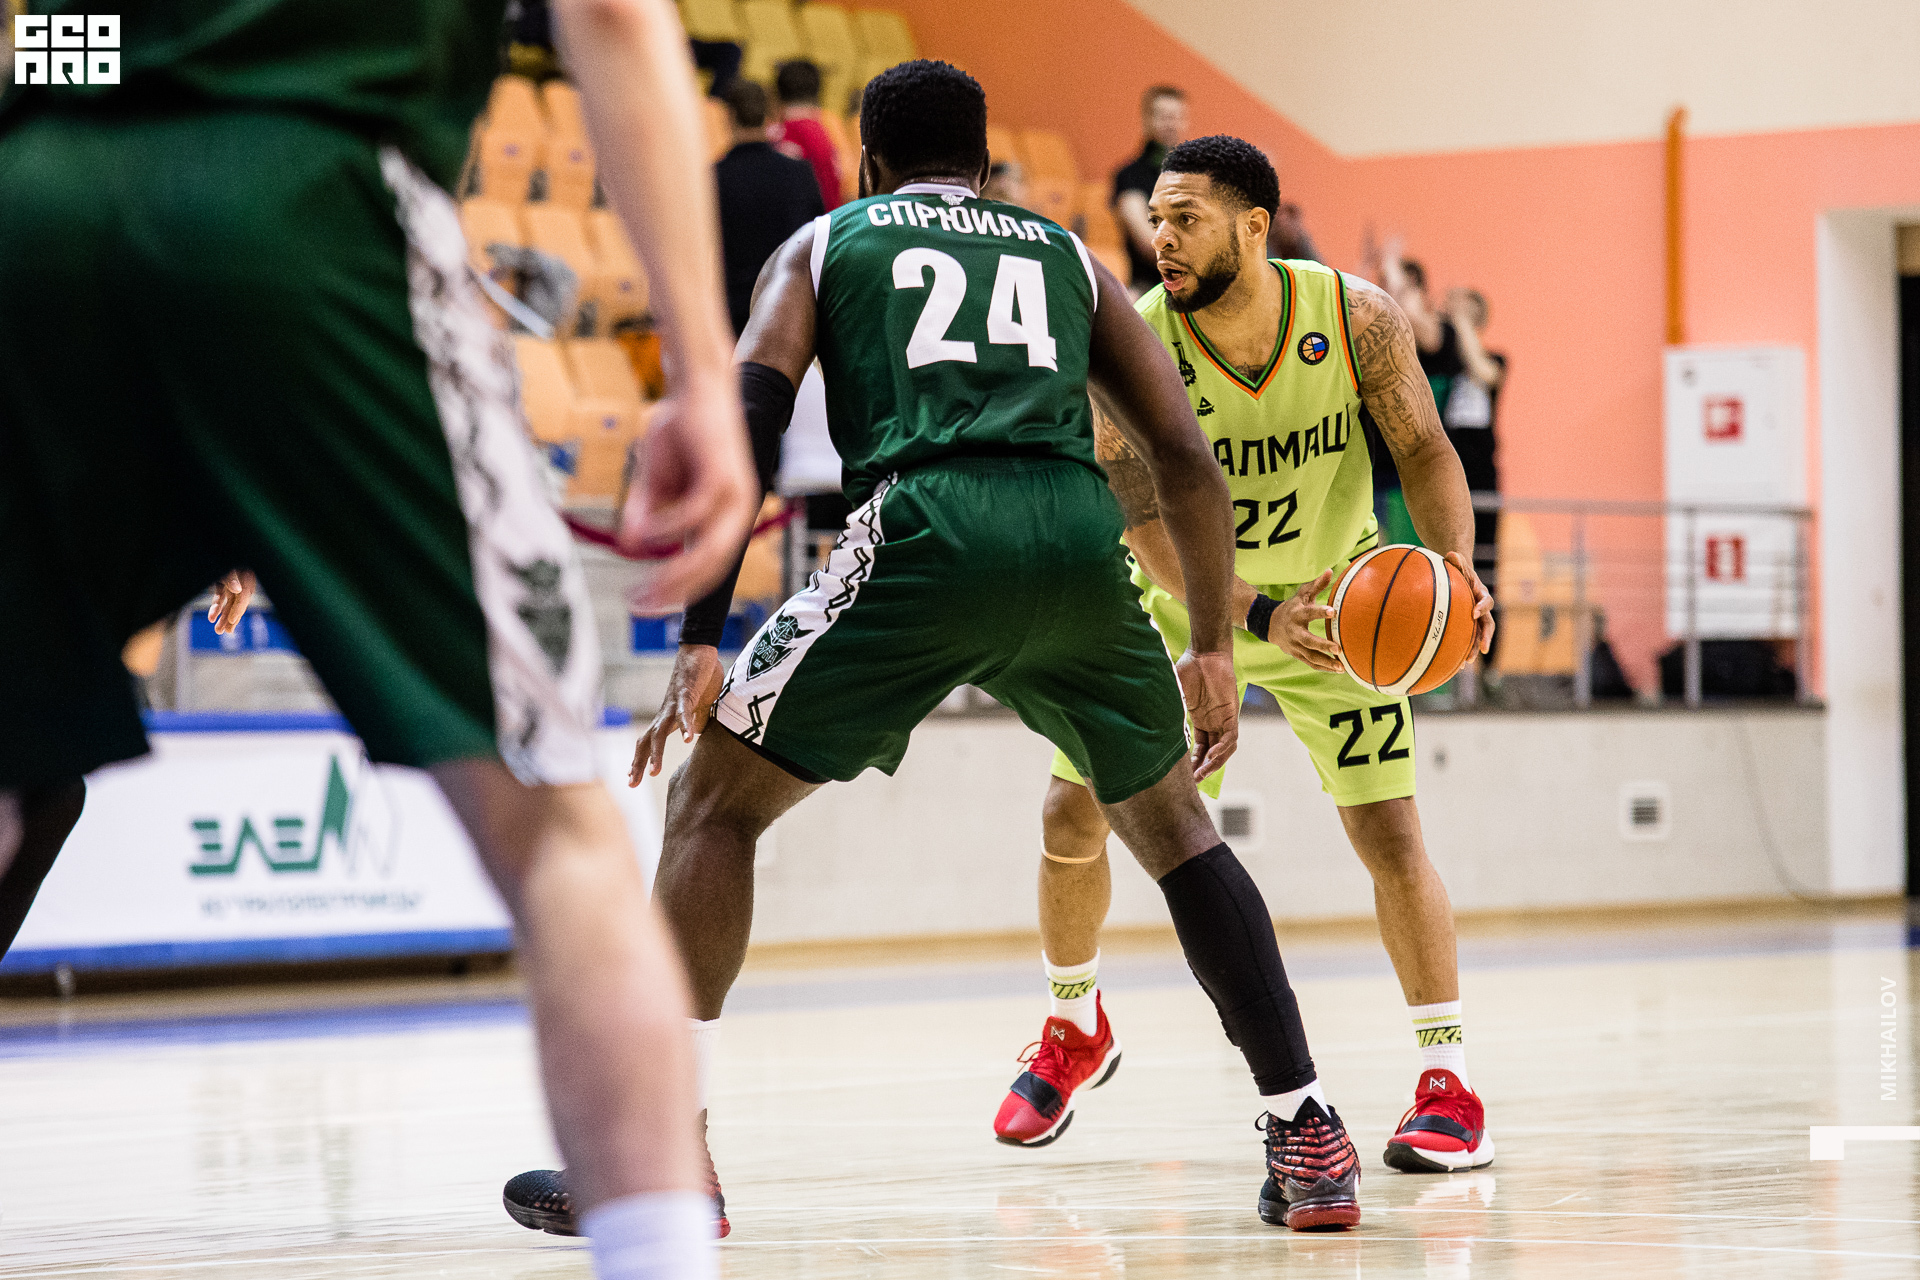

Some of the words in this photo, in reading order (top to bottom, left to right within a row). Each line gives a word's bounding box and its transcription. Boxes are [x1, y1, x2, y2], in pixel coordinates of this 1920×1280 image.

[867, 200, 1051, 245] СПРЮИЛЛ
[892, 247, 1058, 373] 24
[1213, 403, 1350, 477] АЛМАШ
[1232, 488, 1302, 550] 22
[1329, 702, 1410, 770] 22
